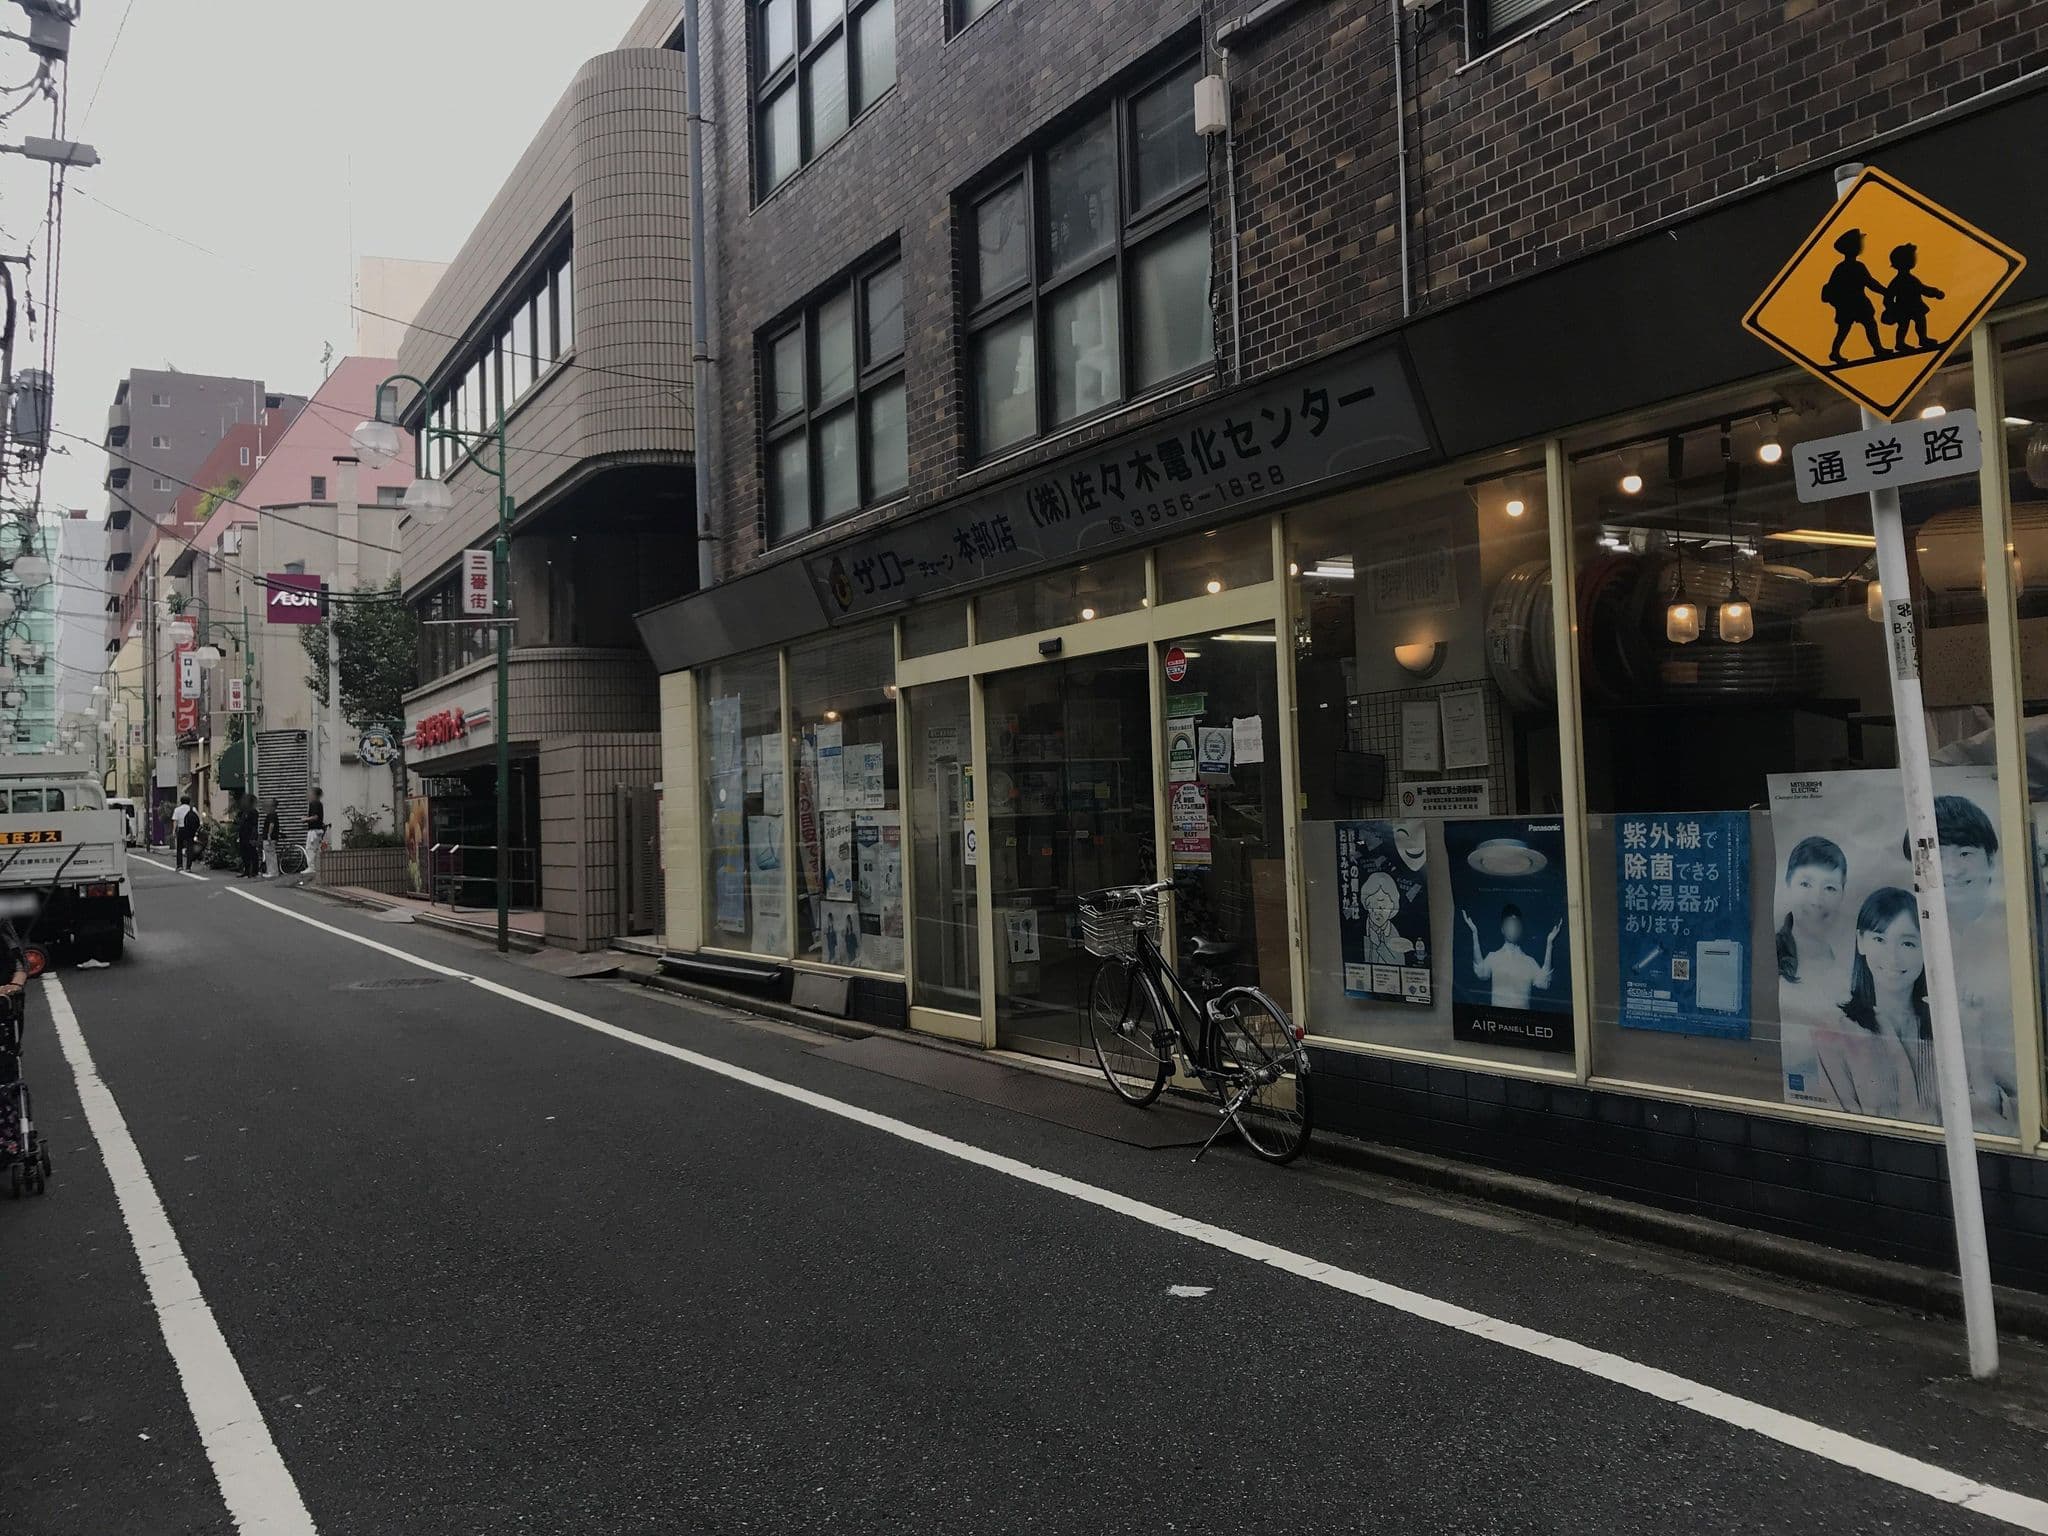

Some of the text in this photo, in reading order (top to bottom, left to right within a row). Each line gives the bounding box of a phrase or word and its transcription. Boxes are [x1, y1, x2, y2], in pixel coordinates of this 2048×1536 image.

[1808, 426, 1963, 487] 通学路
[471, 556, 488, 609] 三番街
[1528, 823, 1561, 832] Panasonic
[1623, 821, 1720, 849] 紫外線で
[1624, 853, 1720, 881] 除菌できる
[1625, 884, 1721, 912] 給湯器が
[1625, 914, 1690, 935] あります。
[1471, 1019, 1554, 1039] AIR PANEL LED
